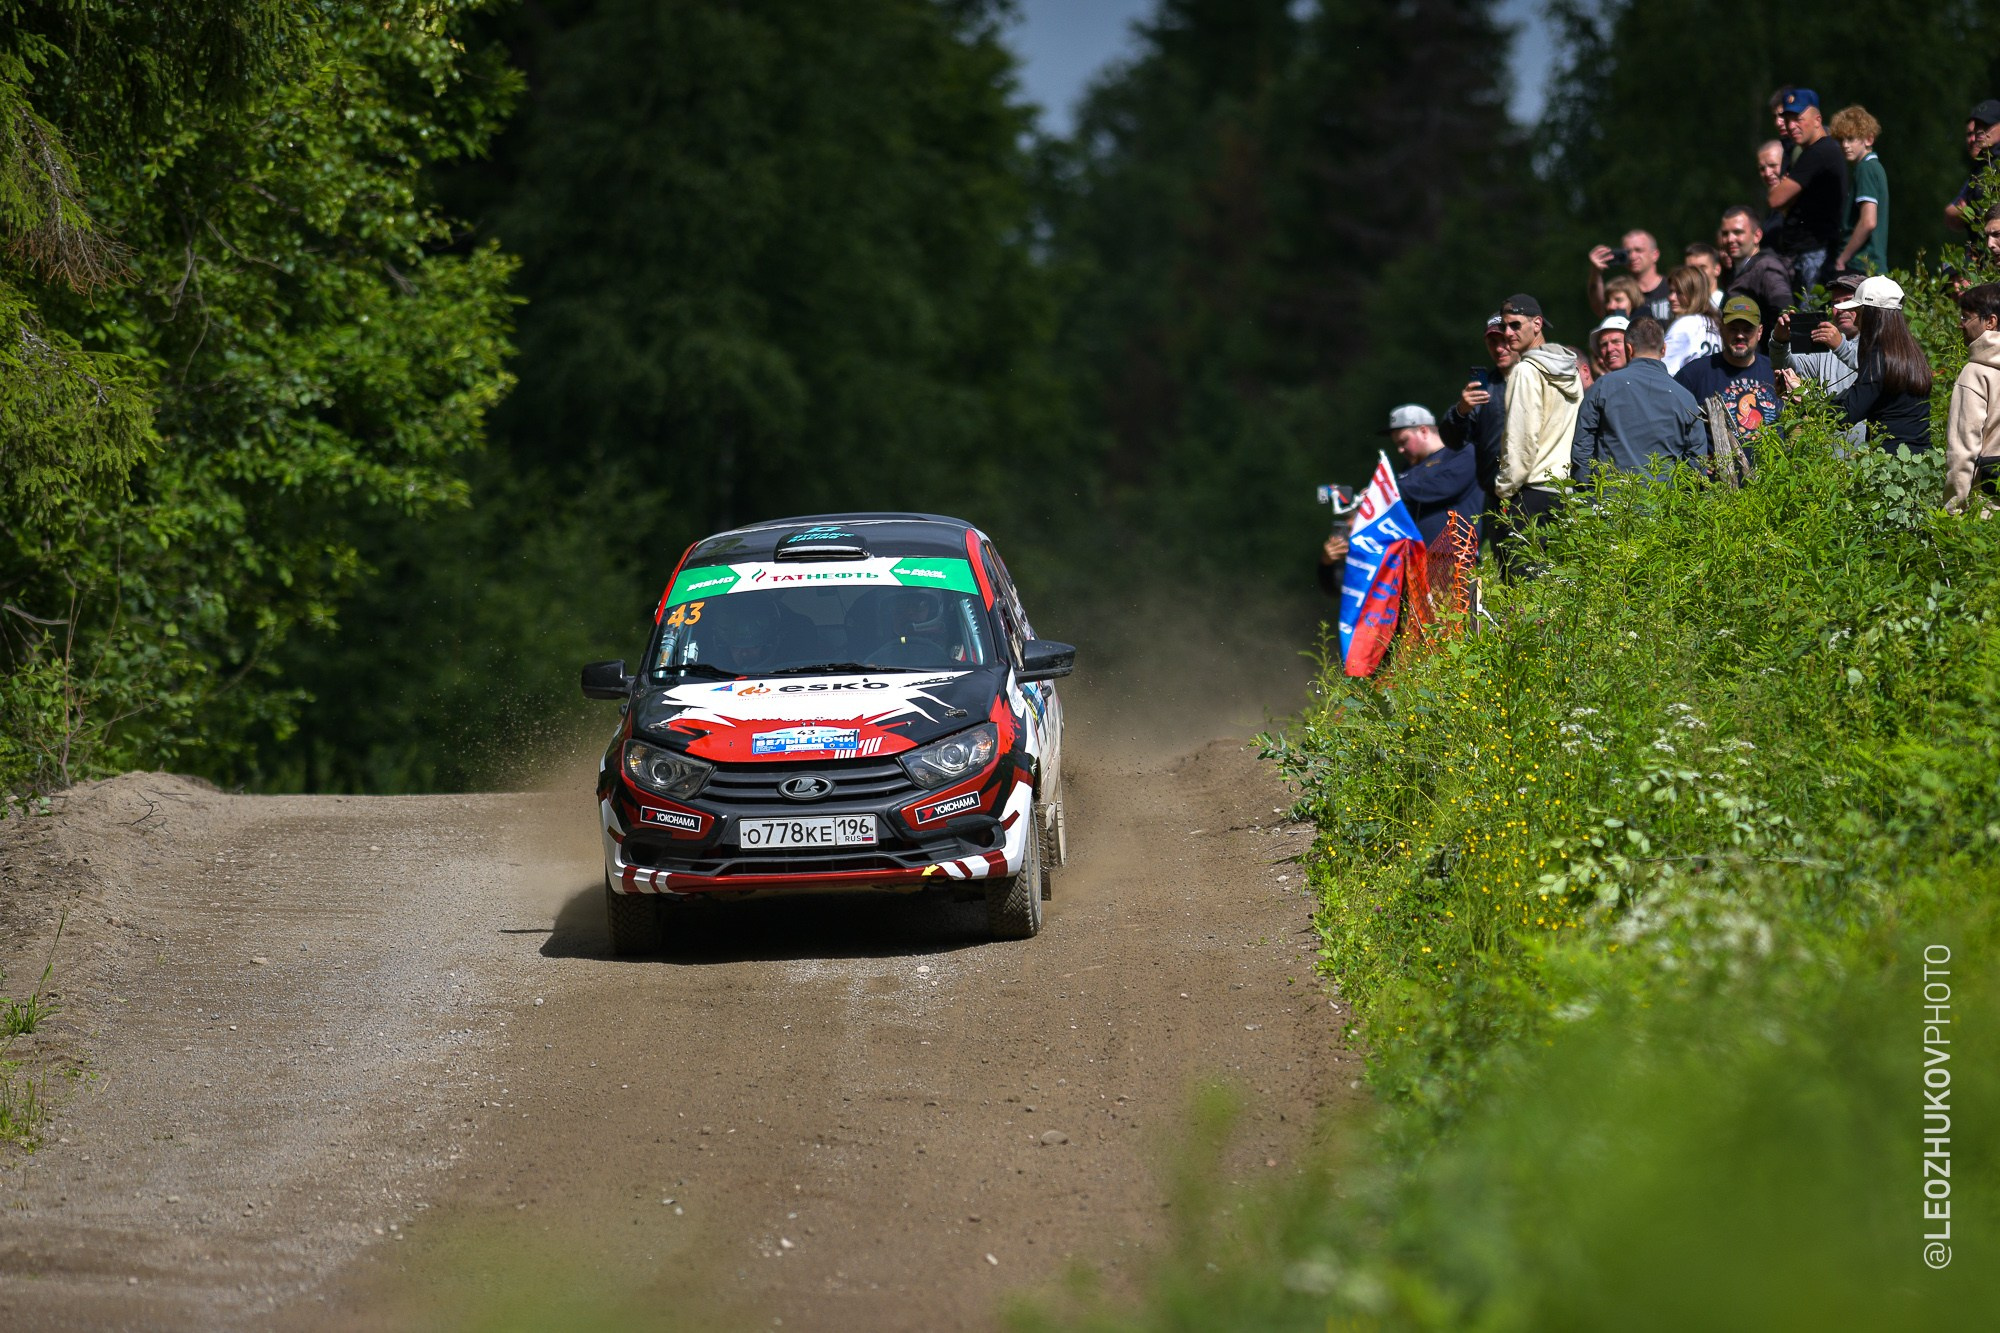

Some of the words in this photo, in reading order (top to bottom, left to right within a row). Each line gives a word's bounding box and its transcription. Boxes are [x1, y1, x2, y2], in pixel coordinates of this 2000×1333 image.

[770, 572, 879, 582] ТАТНЕФТЬ
[667, 601, 705, 628] 43
[811, 735, 855, 744] НОЧИ
[934, 796, 976, 815] YOKOHAMA
[656, 812, 696, 828] YOKOHAMA
[837, 818, 870, 836] 196
